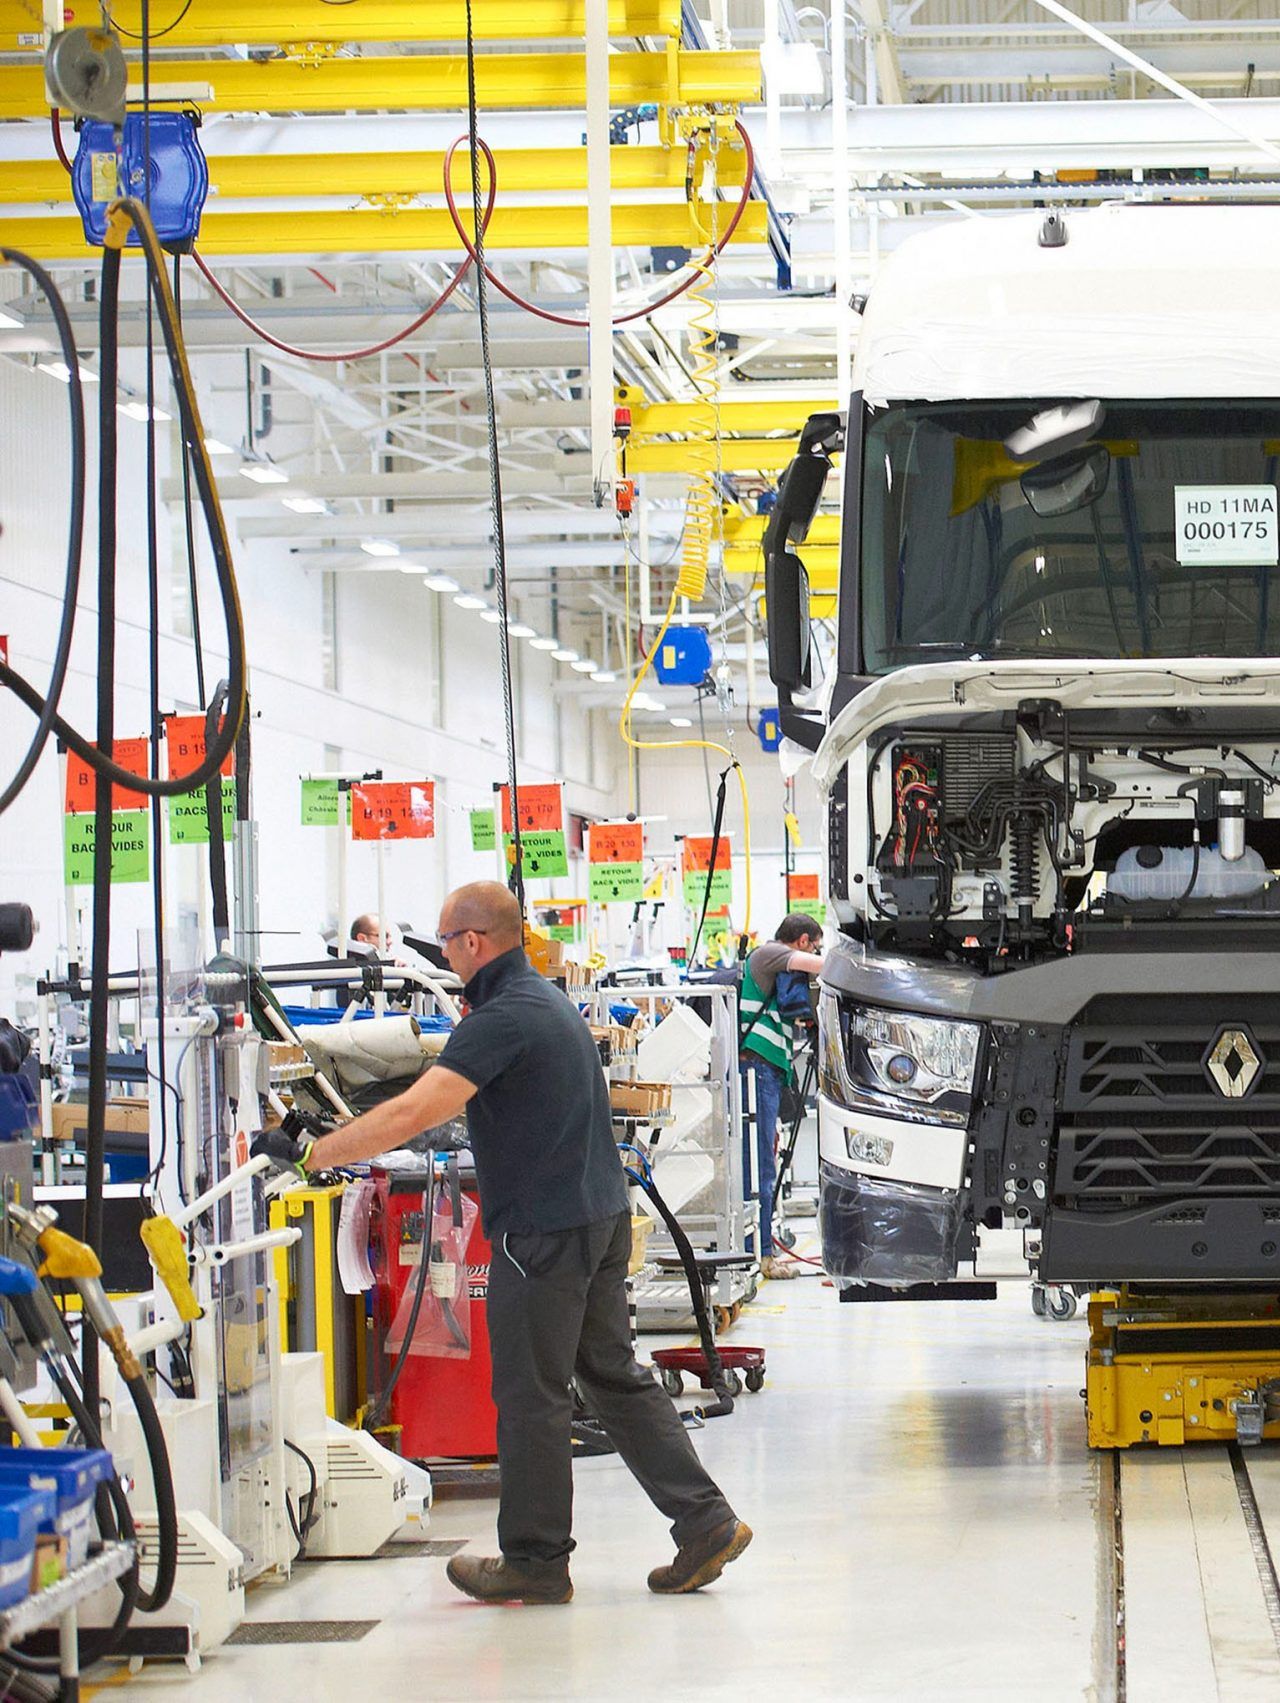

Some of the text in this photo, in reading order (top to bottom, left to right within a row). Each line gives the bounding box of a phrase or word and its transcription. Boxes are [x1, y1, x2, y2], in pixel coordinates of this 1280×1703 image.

[1187, 498, 1274, 514] HD 11MA
[1184, 521, 1268, 540] 000175
[179, 744, 188, 755] B
[79, 773, 88, 785] B
[379, 807, 392, 817] 19
